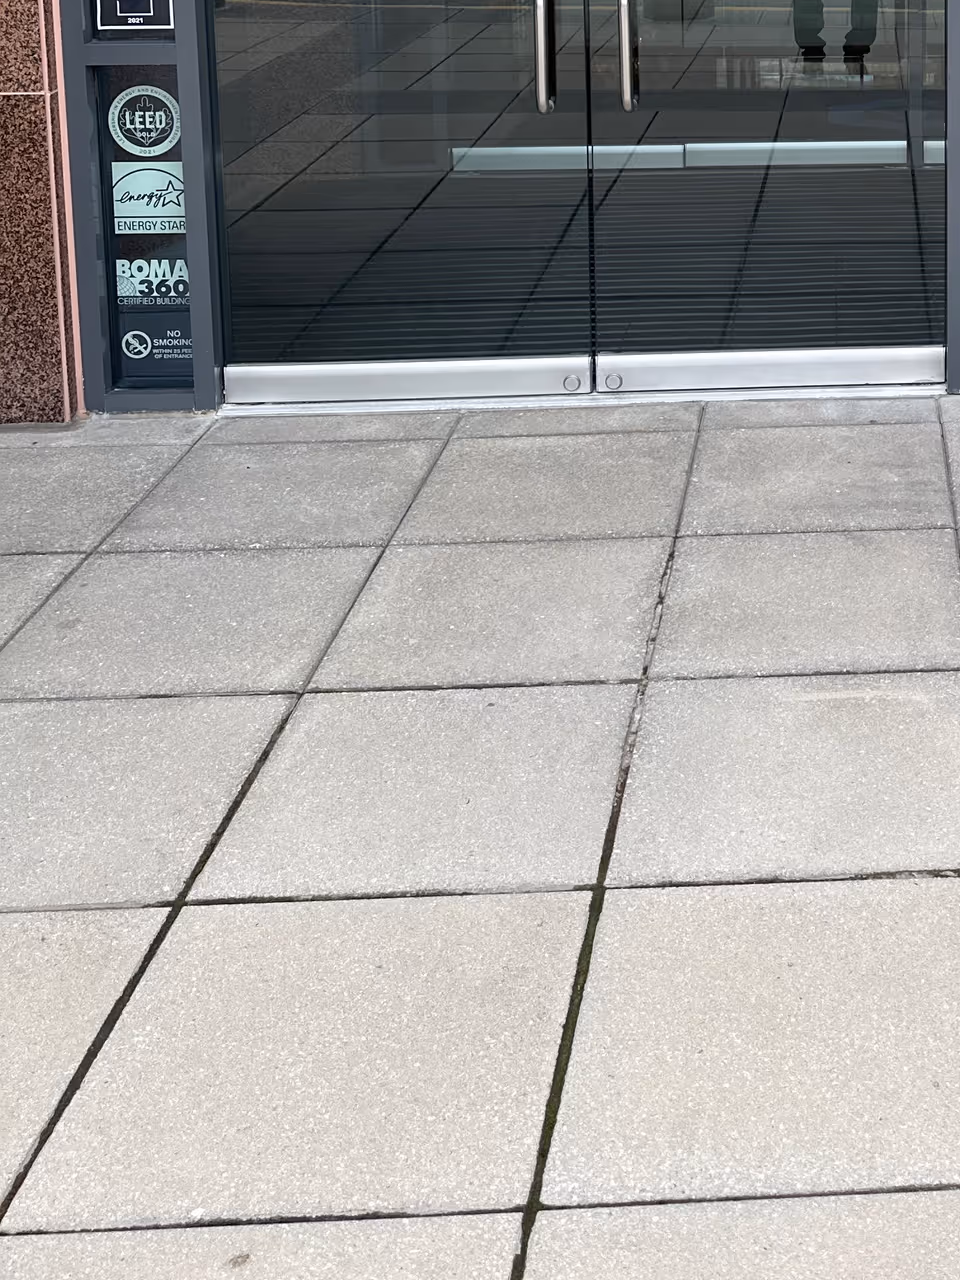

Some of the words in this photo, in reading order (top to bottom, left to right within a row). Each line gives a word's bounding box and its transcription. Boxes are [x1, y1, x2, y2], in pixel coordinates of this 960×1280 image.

[125, 111, 166, 129] LEED
[119, 191, 163, 208] energy
[117, 220, 158, 231] ENERGY
[160, 220, 186, 231] STAR
[116, 259, 189, 279] BOMA
[138, 279, 190, 296] 360
[117, 297, 155, 305] CERTIFIED
[157, 297, 191, 305] BUILDING
